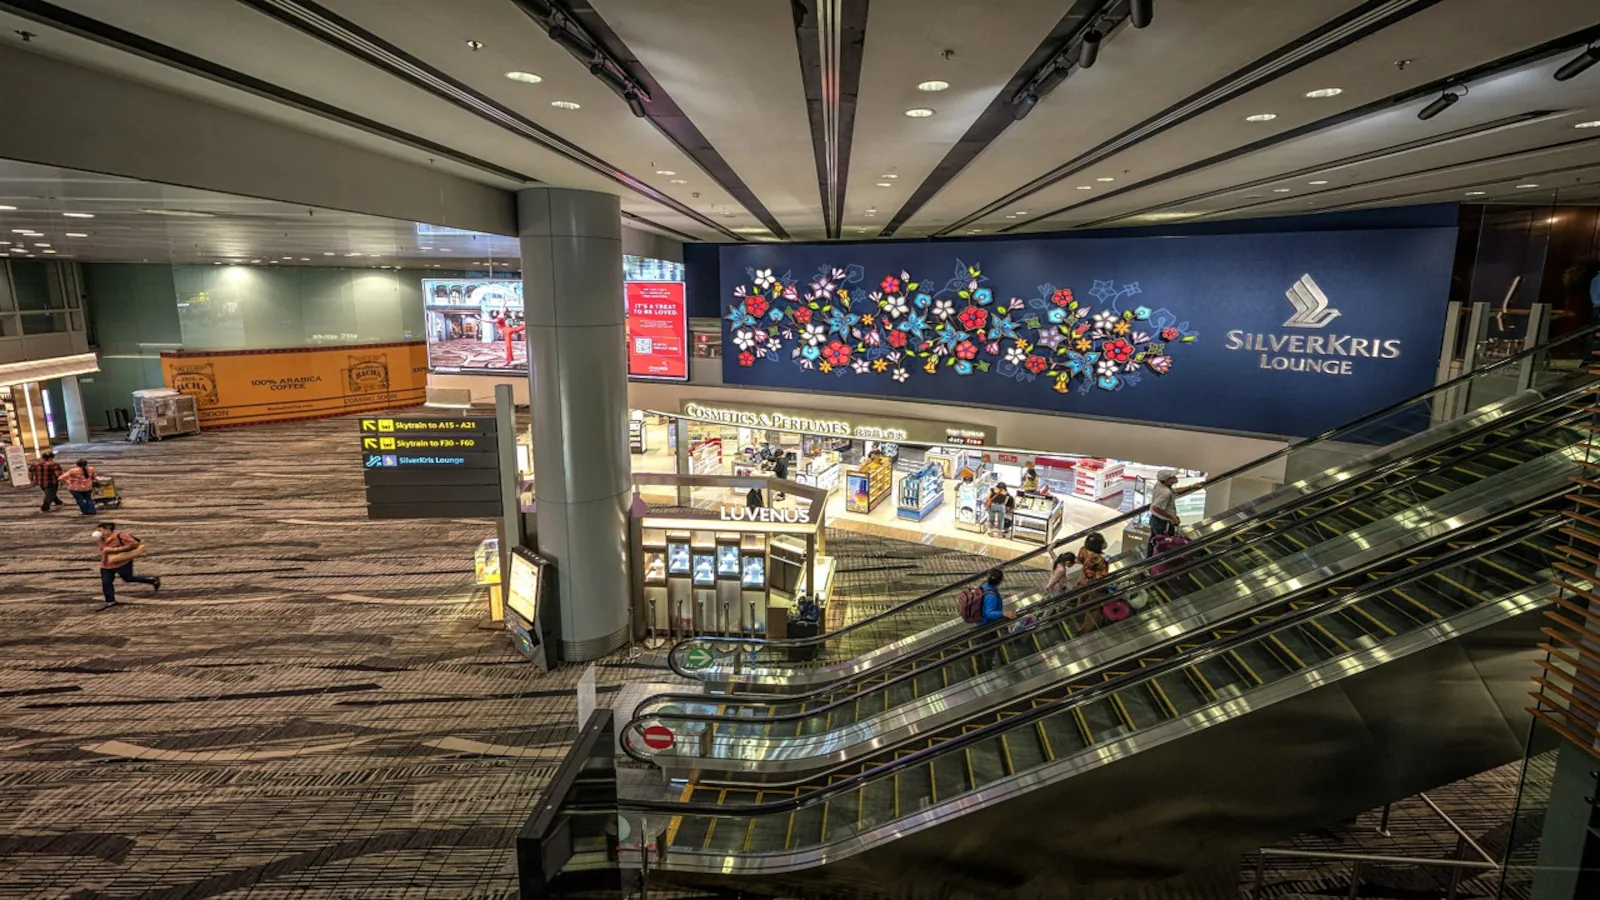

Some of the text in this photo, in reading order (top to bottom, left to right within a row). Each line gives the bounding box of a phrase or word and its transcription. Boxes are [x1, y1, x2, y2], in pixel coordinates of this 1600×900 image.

[1225, 329, 1401, 359] SILVERKRIS
[1259, 353, 1353, 375] LOUNGE
[356, 369, 381, 380] BACHA
[279, 376, 322, 384] ARABICA
[270, 383, 306, 391] COFFEE
[344, 395, 376, 404] COMING
[202, 409, 230, 418] SOON
[685, 403, 848, 434] COSMETICS & PERFUMES
[395, 421, 427, 430] Skytrain
[396, 440, 429, 448] Skytrain
[948, 437, 964, 445] duty
[399, 456, 465, 465] SilverKris Lounge
[720, 505, 810, 523] LUVENUS
